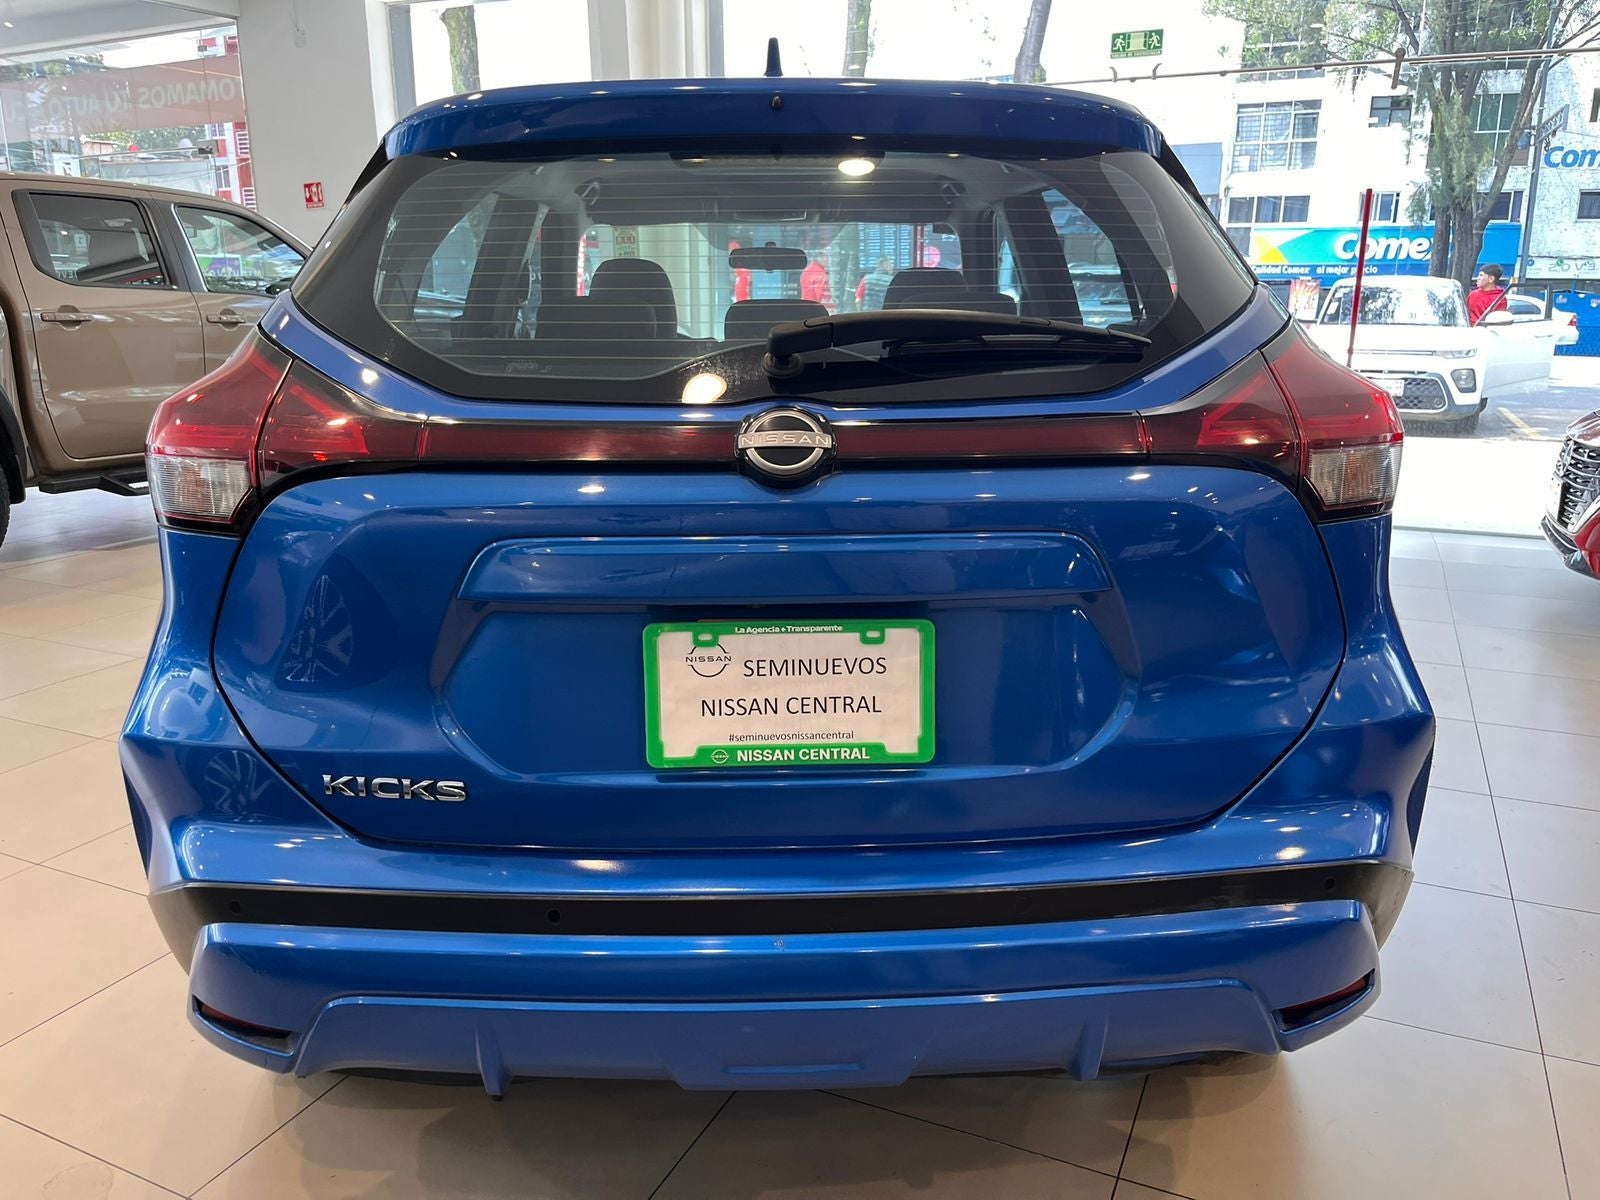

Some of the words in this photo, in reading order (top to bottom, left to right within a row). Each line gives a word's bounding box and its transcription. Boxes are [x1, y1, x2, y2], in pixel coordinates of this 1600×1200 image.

[1333, 232, 1435, 261] Come
[1282, 265, 1310, 274] Comex
[1326, 266, 1349, 276] mejor
[1350, 265, 1378, 276] pcio
[741, 434, 829, 446] NISSAN
[735, 626, 745, 634] La
[746, 625, 780, 635] Agencia
[685, 655, 732, 663] NISSAN
[743, 656, 887, 677] SEMINUEVOS
[701, 697, 778, 717] NISSAN
[786, 695, 882, 715] CENTRAL
[728, 730, 854, 742] #seminuevosnissancentral
[737, 748, 795, 762] NISSAN
[798, 747, 871, 761] CENTRAL
[322, 774, 467, 802] KICKS
